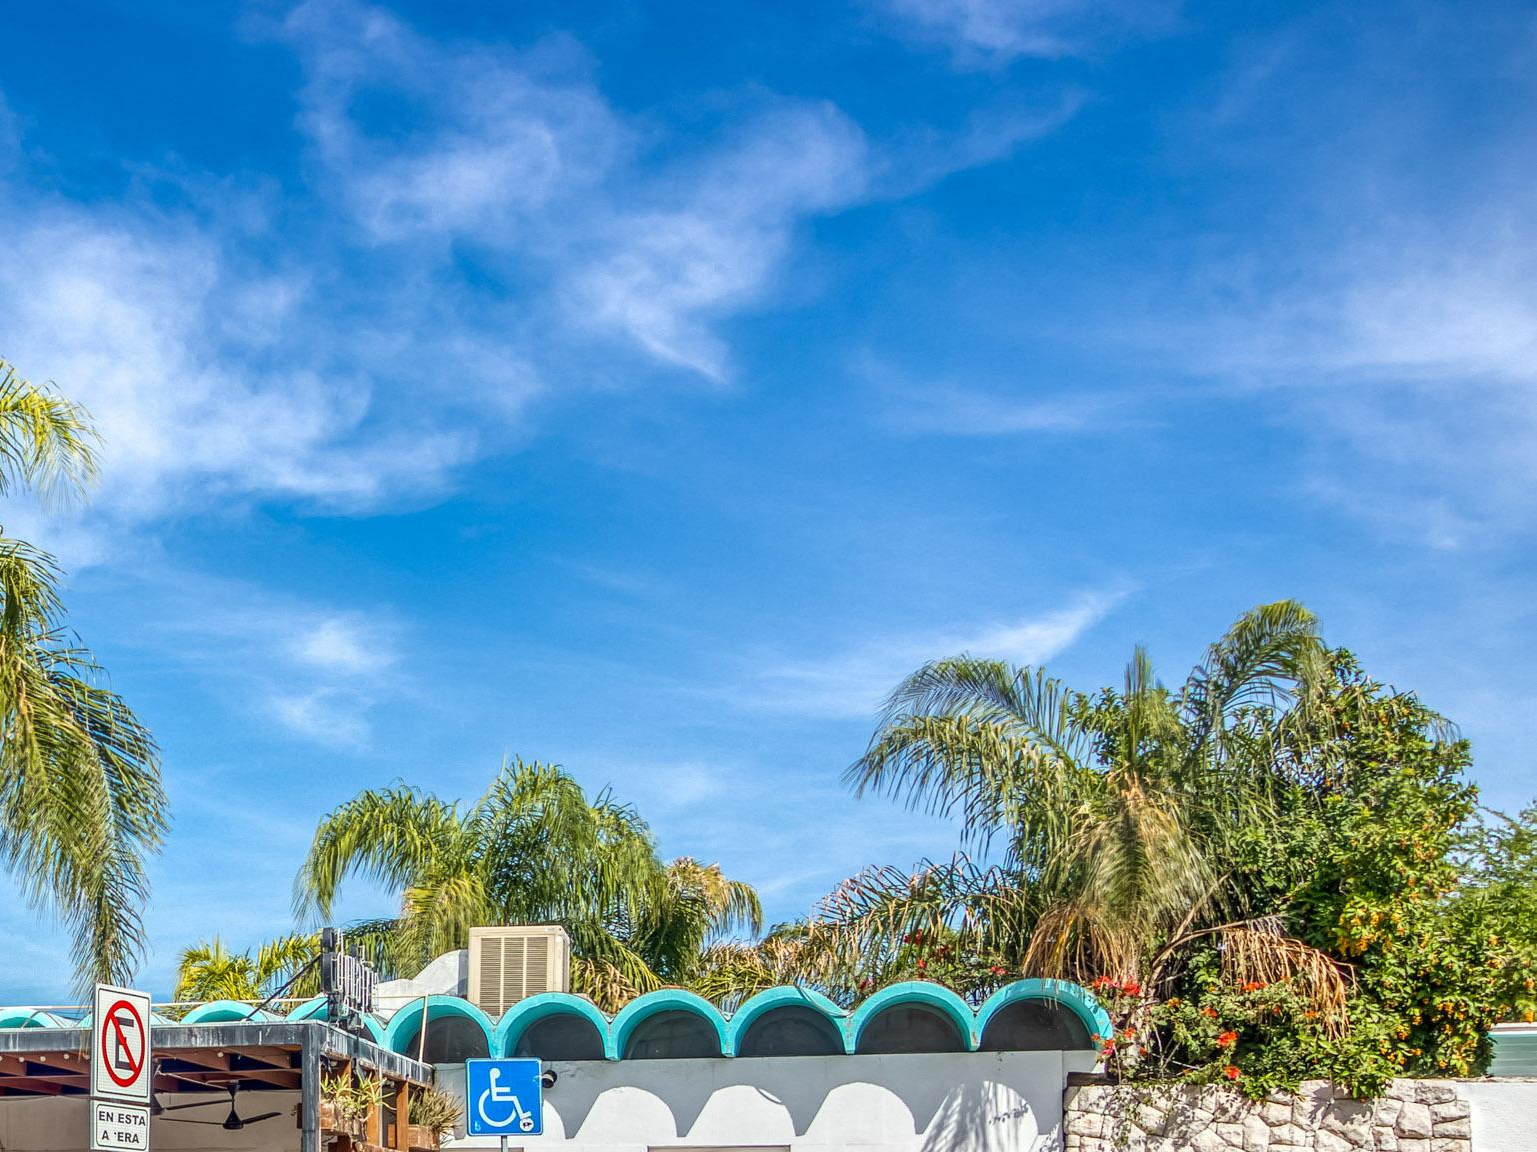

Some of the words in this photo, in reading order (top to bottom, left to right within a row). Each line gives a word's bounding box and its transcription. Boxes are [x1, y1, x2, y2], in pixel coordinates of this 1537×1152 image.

[99, 1111, 113, 1122] EN
[118, 1113, 146, 1126] ESTA
[102, 1130, 139, 1144] AERA
